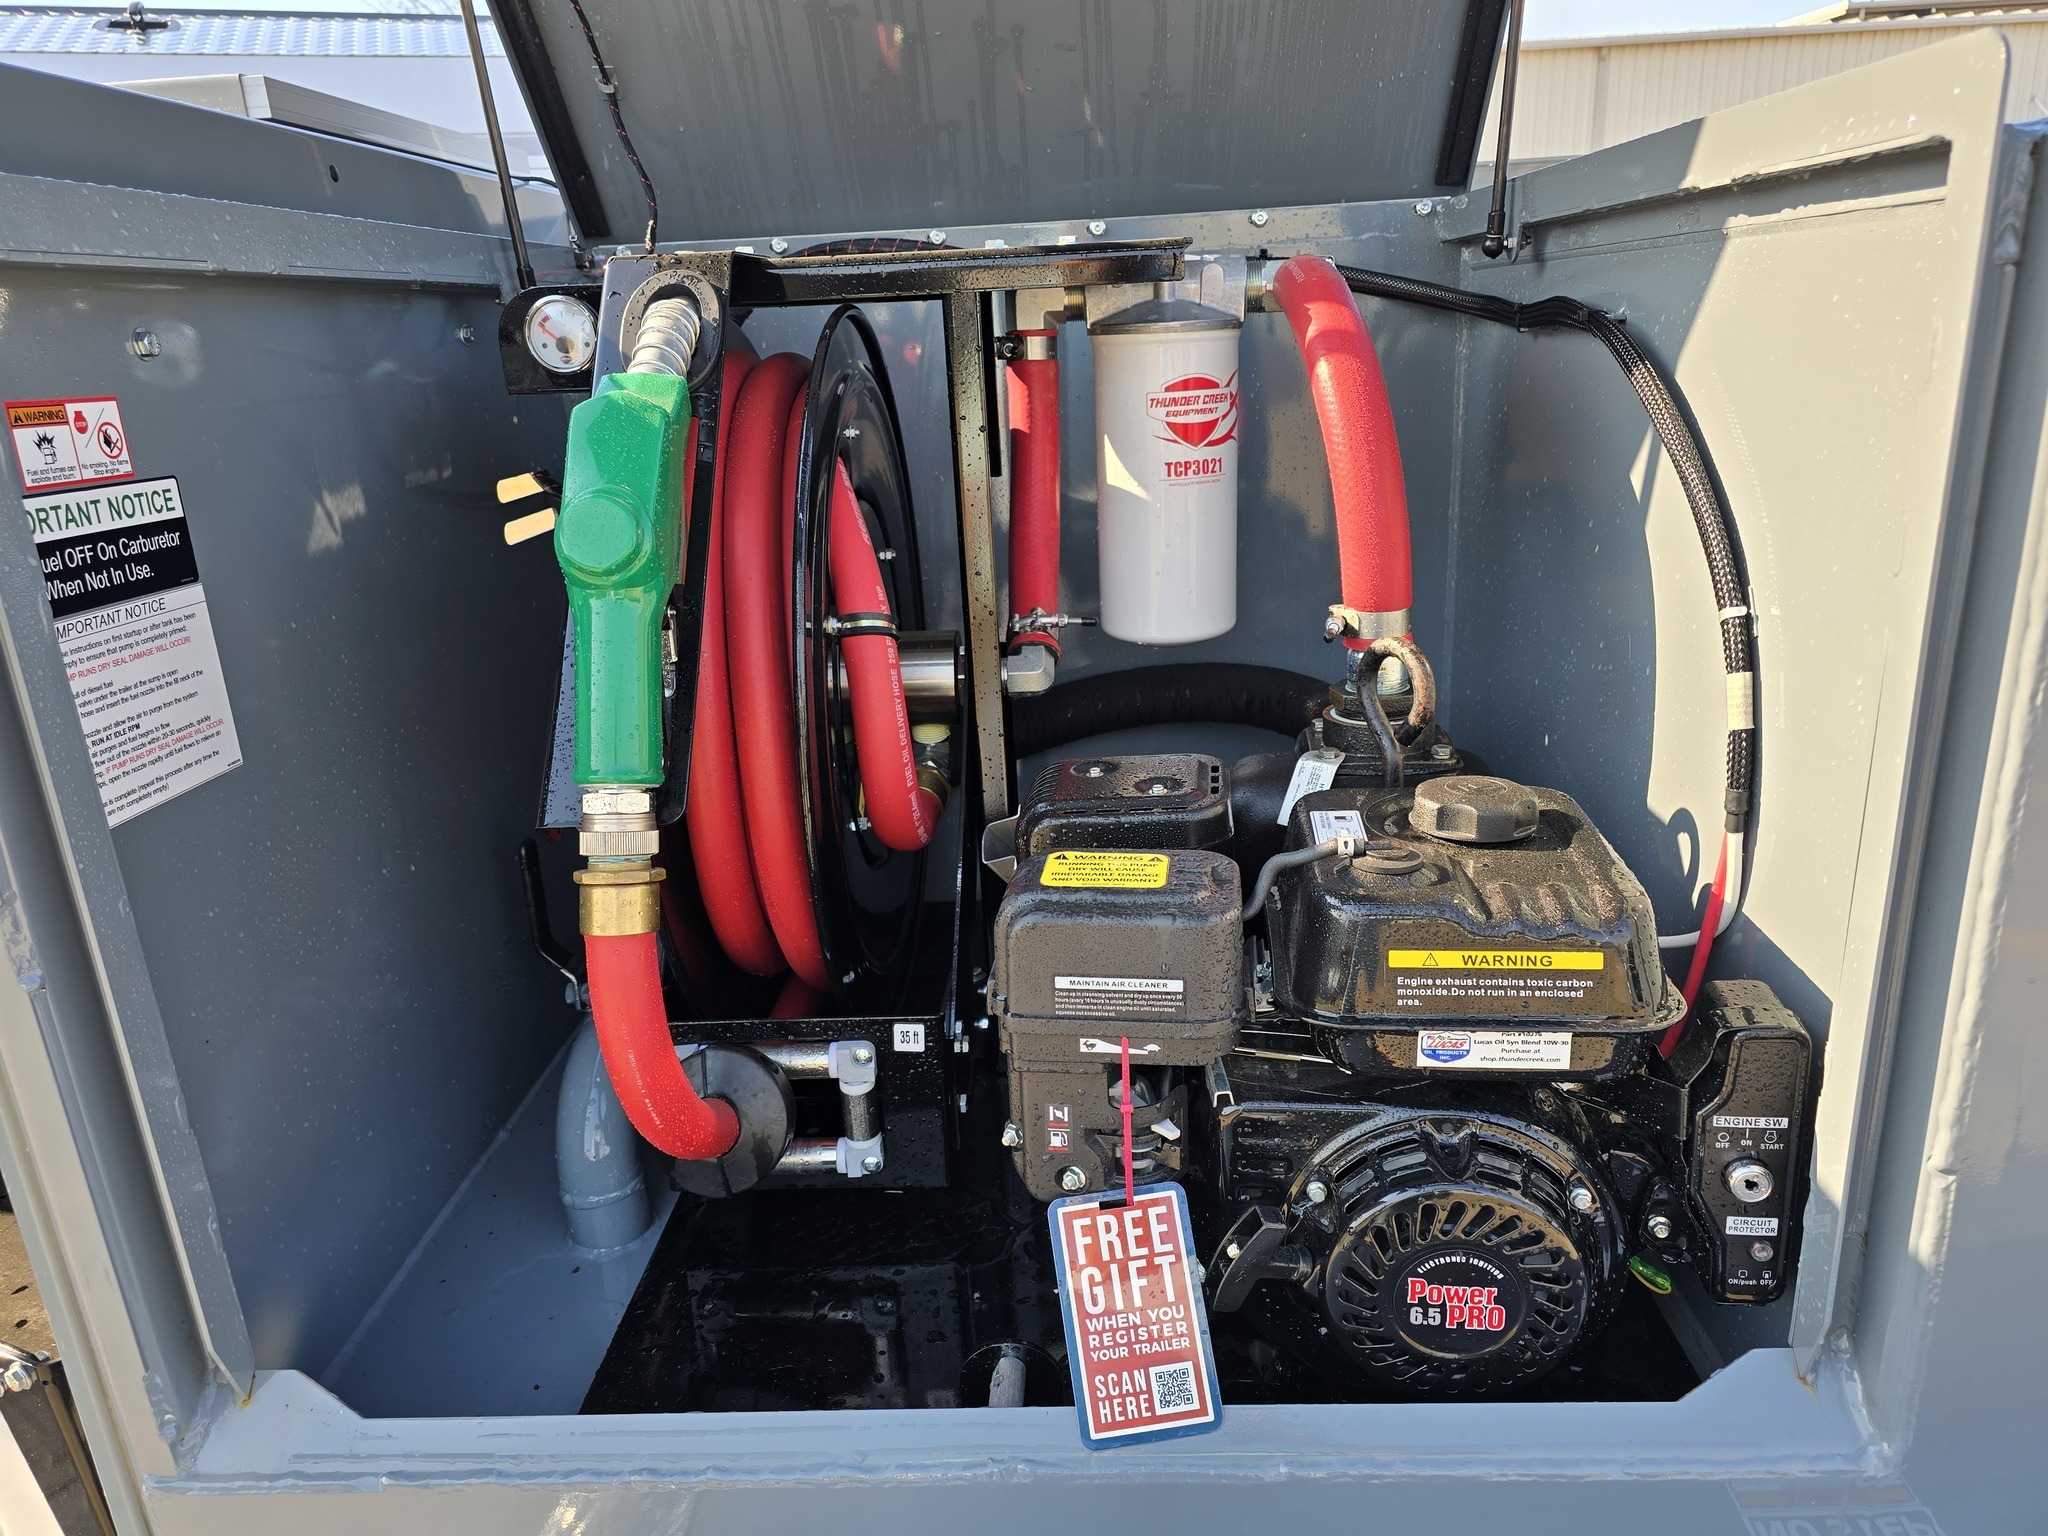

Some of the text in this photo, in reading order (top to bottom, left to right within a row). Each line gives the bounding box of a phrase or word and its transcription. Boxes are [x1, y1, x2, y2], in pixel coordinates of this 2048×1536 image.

[1149, 392, 1228, 408] THUNDER CREEK
[1165, 406, 1219, 417] EQUIPMENT
[24, 410, 64, 422] WARNING
[90, 462, 108, 471] smoking.
[94, 469, 103, 477] Stop
[1165, 458, 1222, 477] TCP3021
[31, 475, 51, 484] explode
[108, 488, 176, 522] NOTICE
[42, 531, 180, 573] uel OFF On Carburetor
[46, 563, 154, 601] When Not In Use.
[125, 597, 167, 621] NOTICE
[68, 639, 103, 655] instructions
[103, 637, 111, 645] on
[111, 633, 122, 642] first
[122, 628, 142, 640] startup
[148, 621, 161, 631] after
[161, 618, 172, 627] tank
[173, 615, 183, 623] has
[183, 611, 196, 620] been
[78, 656, 85, 664] to
[85, 650, 106, 662] ensure
[106, 645, 117, 655] that
[118, 641, 134, 653] pump
[134, 638, 140, 646] is
[140, 630, 168, 646] completely
[168, 624, 187, 637] primed:
[77, 665, 97, 678] RUNS
[97, 661, 111, 672] DRY
[111, 655, 128, 667] SEAL
[128, 647, 154, 662] DAMAGE
[154, 642, 169, 653] WILL
[168, 634, 191, 648] OCCUR!
[894, 668, 904, 697] HOSE
[90, 722, 140, 747] RUN AT IDLE RPM
[896, 699, 908, 747] DELIVERY
[907, 764, 915, 788] FUEL
[1462, 954, 1553, 967] WARNING
[1397, 977, 1593, 988] Engine exhaust contains toxic carbon
[1397, 987, 1466, 996] monoxide.Do
[1468, 988, 1485, 996] not
[1488, 989, 1505, 997] run
[1508, 989, 1517, 997] in
[1535, 989, 1584, 998] enclosed
[900, 1030, 920, 1045] 35 ft
[1427, 1040, 1467, 1048] LUCAS
[1715, 1117, 1786, 1127] ENGINE SW.
[1728, 1226, 1776, 1234] PROTECTOR
[1733, 1219, 1773, 1227] CIRCUIT
[1073, 1205, 1173, 1266] FREE
[1417, 1256, 1504, 1280] ELECTRONIC IGNITION
[1081, 1254, 1176, 1315] GIFT
[1408, 1278, 1498, 1306] Power
[1085, 1305, 1185, 1333] WHEN YOU
[1410, 1305, 1506, 1331] 6.5 PRO
[1089, 1321, 1189, 1348] REGISTER
[1090, 1337, 1190, 1363] YOUR TRAILER
[1094, 1368, 1147, 1399] SCAN
[1098, 1394, 1152, 1424] HERE
